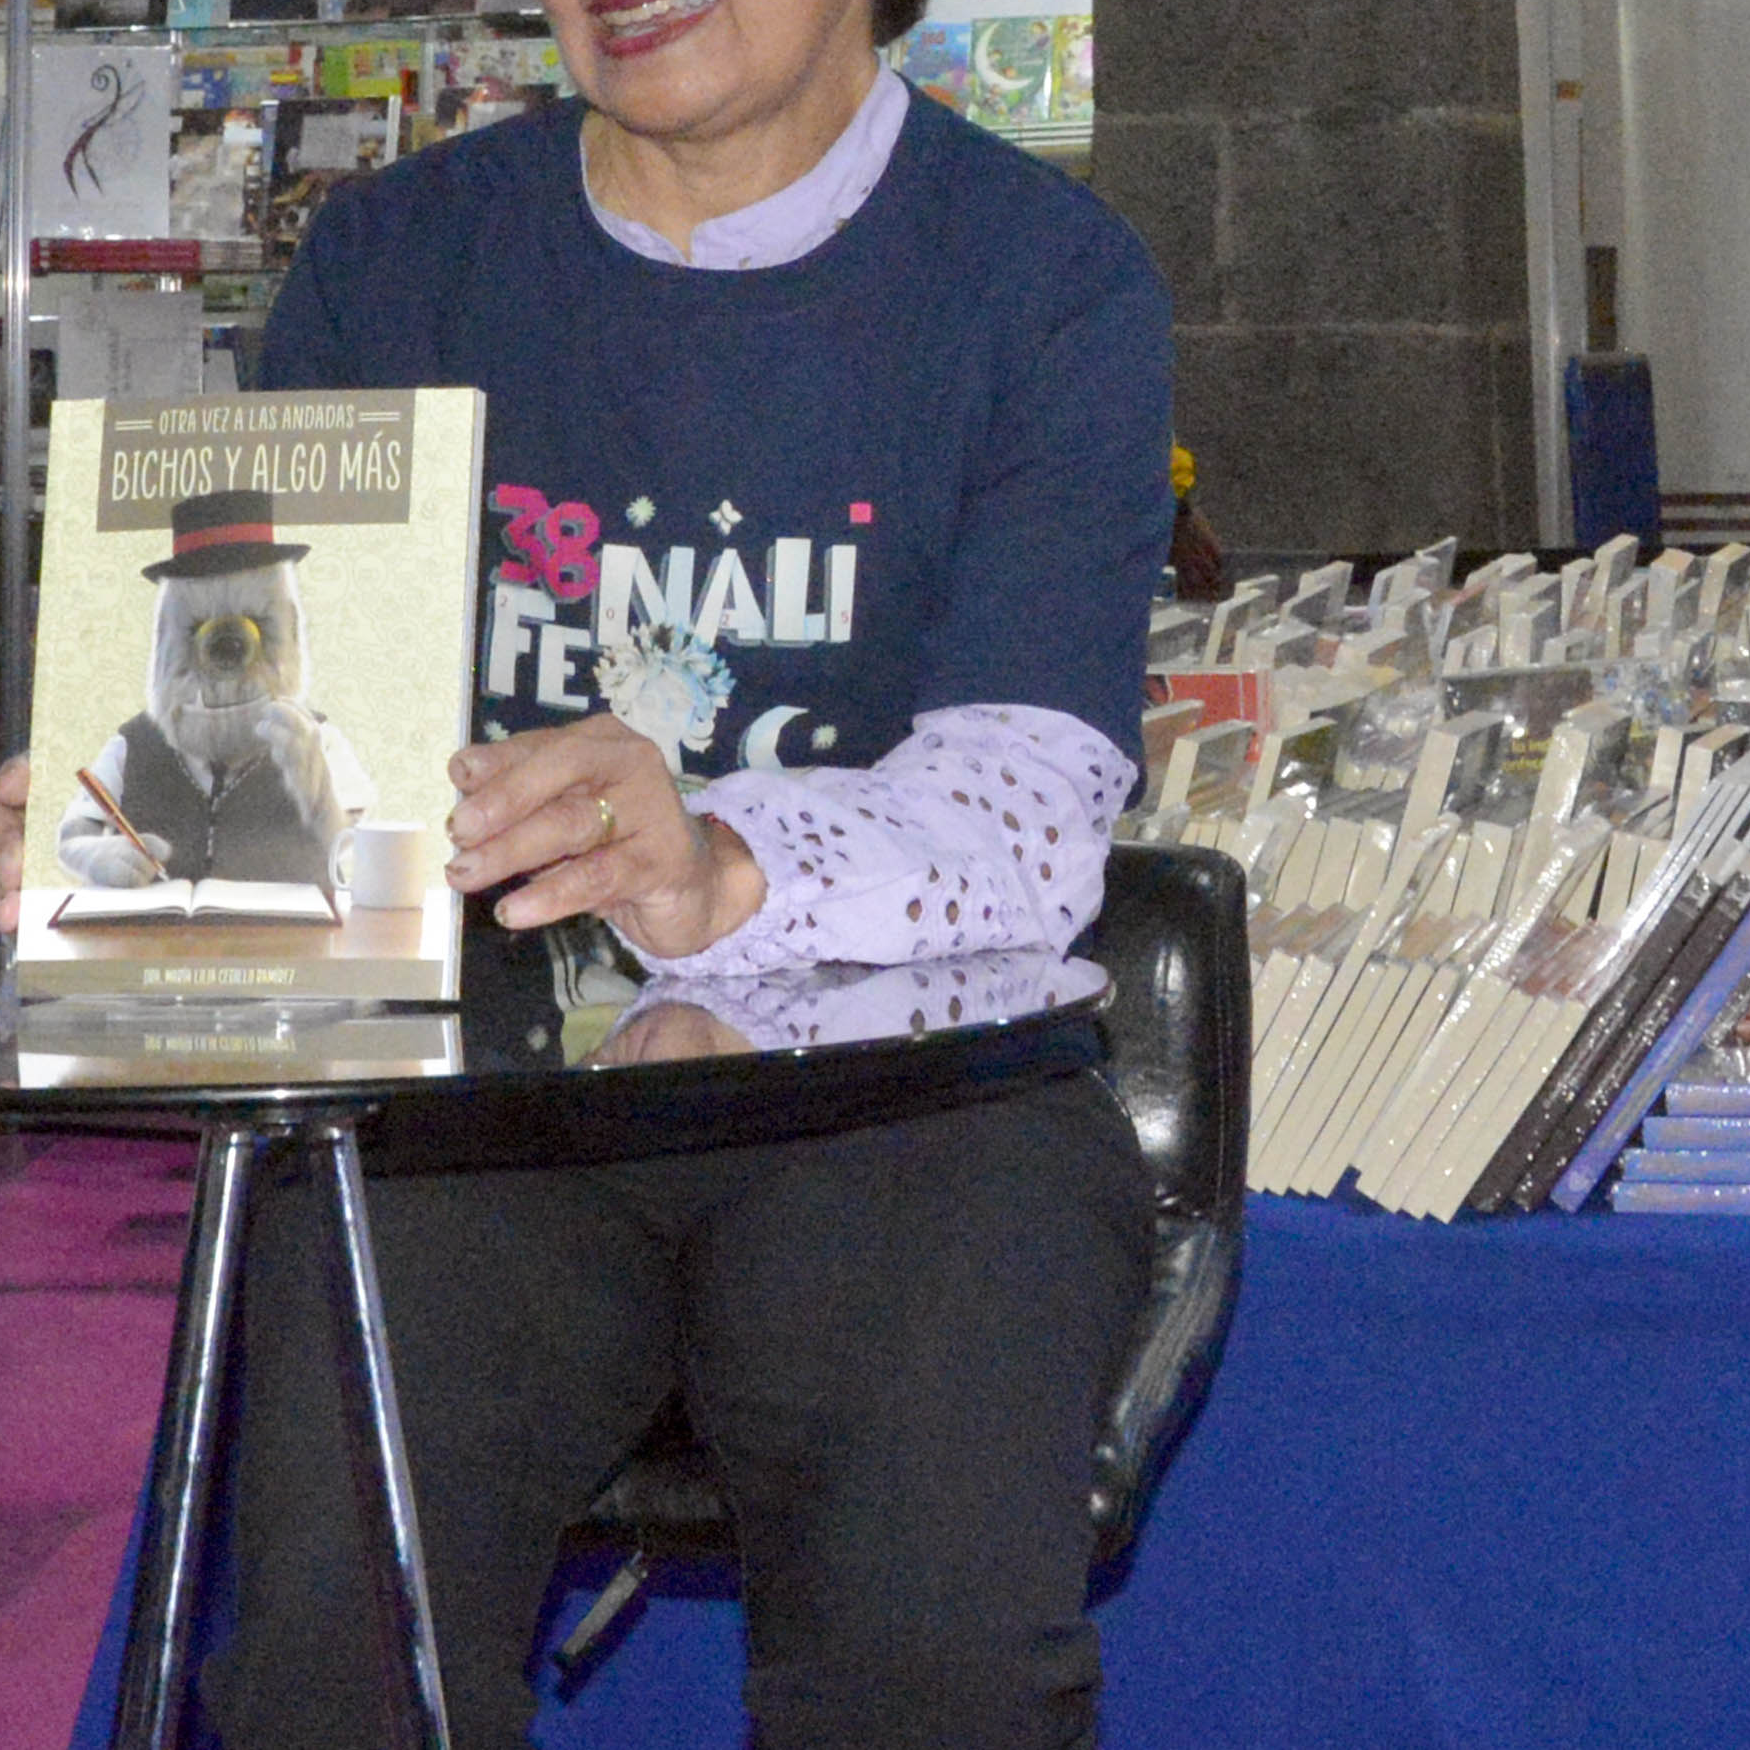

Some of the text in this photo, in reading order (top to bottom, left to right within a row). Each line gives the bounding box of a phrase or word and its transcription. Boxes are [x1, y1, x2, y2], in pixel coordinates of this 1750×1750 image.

[158, 404, 355, 435] OTRA VEZ A LAS ANDADAS
[111, 430, 401, 501] BICHOS Y ALGO MÁS
[494, 483, 601, 600] 38
